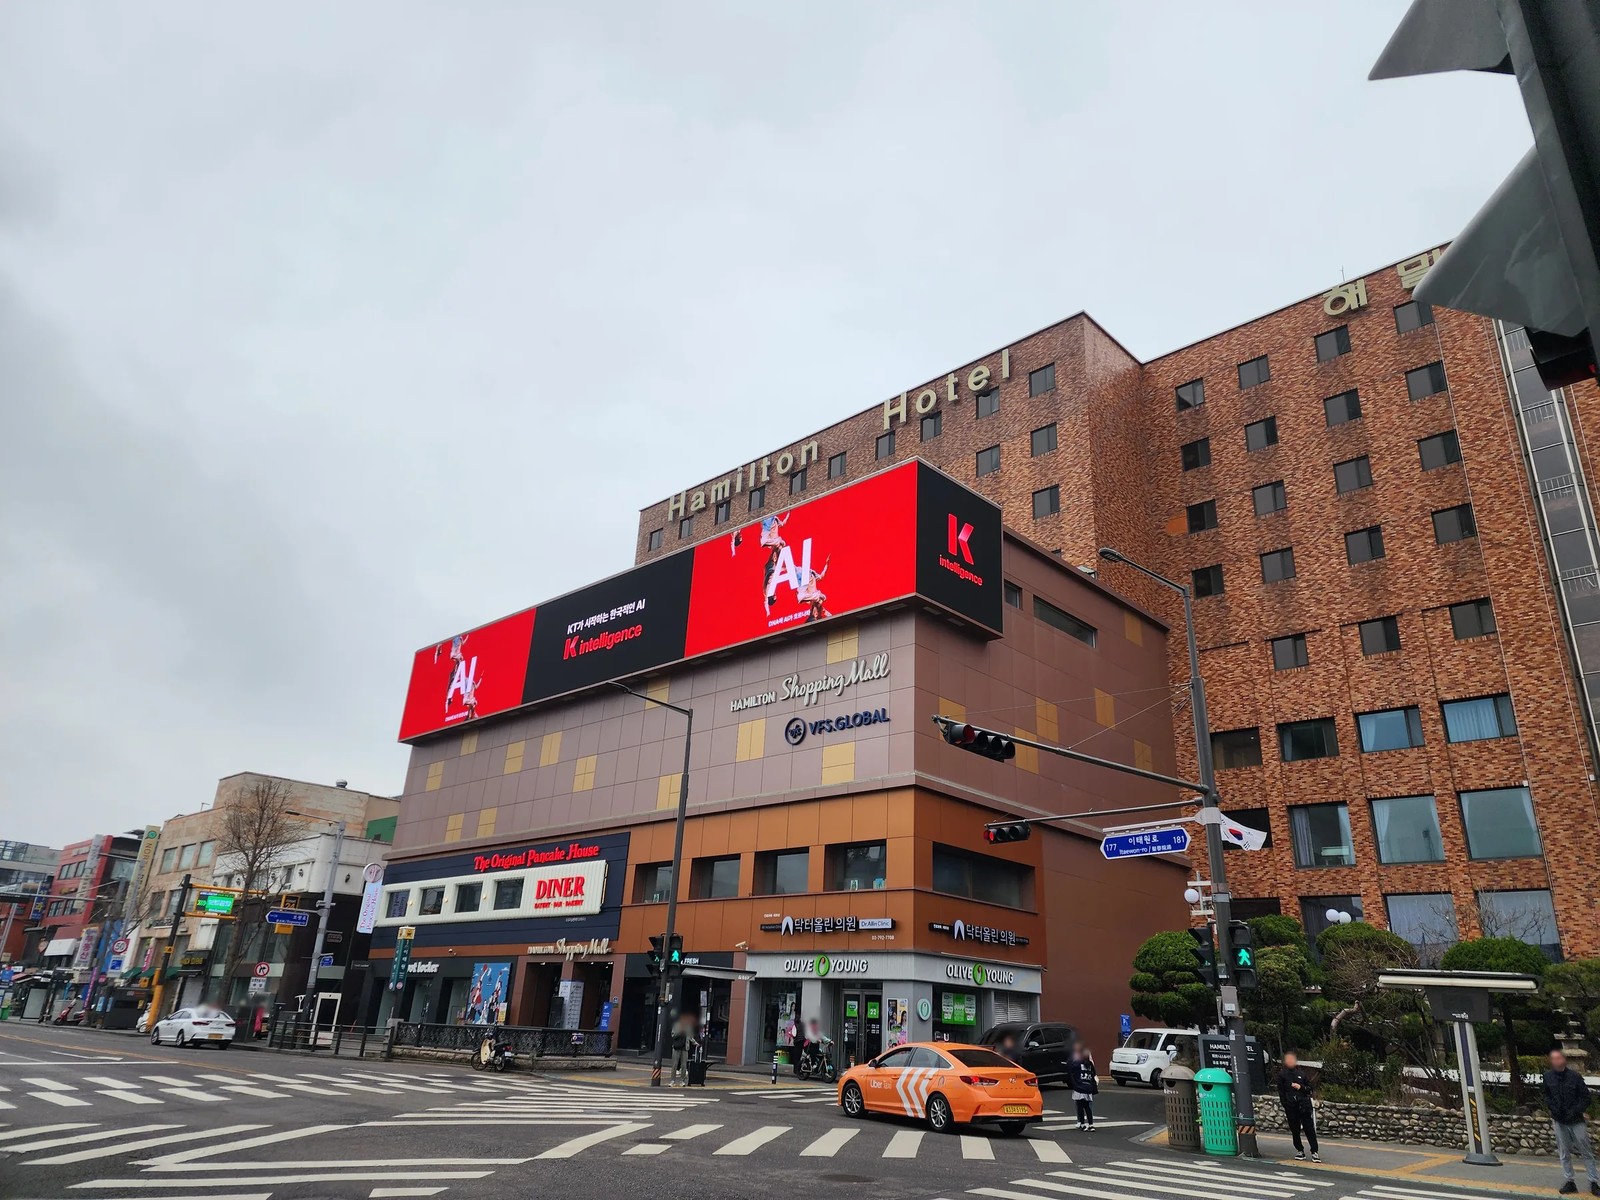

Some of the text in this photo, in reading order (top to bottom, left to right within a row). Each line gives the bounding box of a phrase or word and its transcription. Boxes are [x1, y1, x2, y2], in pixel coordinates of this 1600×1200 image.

[667, 348, 1011, 522] Hamilton Hotel
[767, 538, 812, 597] AI
[939, 553, 984, 587] intelligence
[567, 598, 646, 634] KT가 시작하는 한국적인 AI
[563, 625, 642, 660] K intelligence
[446, 655, 478, 700] AI
[730, 652, 891, 713] HAMILTON Shopping Mall
[809, 707, 890, 735] VFS.GLOBAL
[1128, 835, 1159, 845] 이태원로
[1173, 836, 1185, 844] 181
[473, 842, 600, 872] The Original Pancake House
[535, 876, 585, 899] DINER
[794, 917, 834, 933] 닥터올린
[835, 916, 856, 932] 의원
[877, 919, 890, 927] Clinic
[966, 924, 999, 944] 닥터올린
[1000, 930, 1016, 946] 의원
[115, 942, 124, 951] 50
[784, 959, 868, 973] OLIVE YOUNG
[946, 964, 1014, 984] OLIVE YOUNG
[870, 1079, 892, 1090] Uber Taxi
